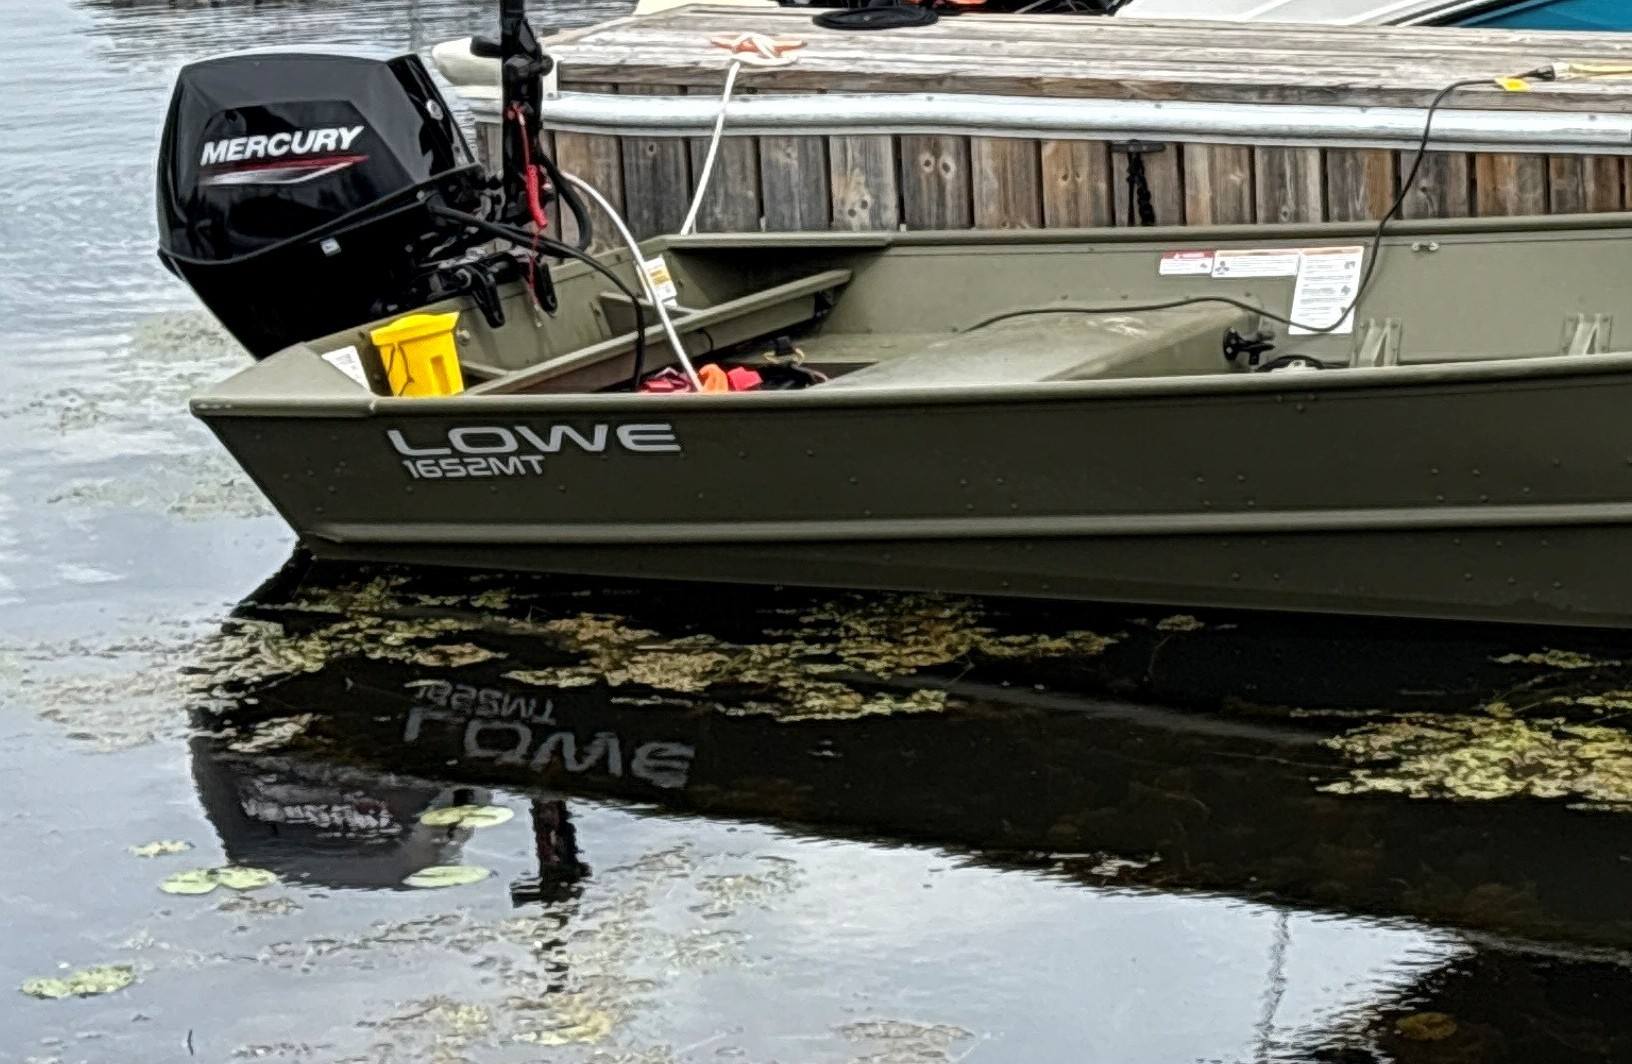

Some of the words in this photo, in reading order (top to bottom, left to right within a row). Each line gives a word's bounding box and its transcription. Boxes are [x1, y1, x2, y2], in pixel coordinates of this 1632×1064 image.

[200, 126, 364, 166] MERCURY
[387, 424, 682, 456] LOWE
[402, 455, 545, 479] 1652MT
